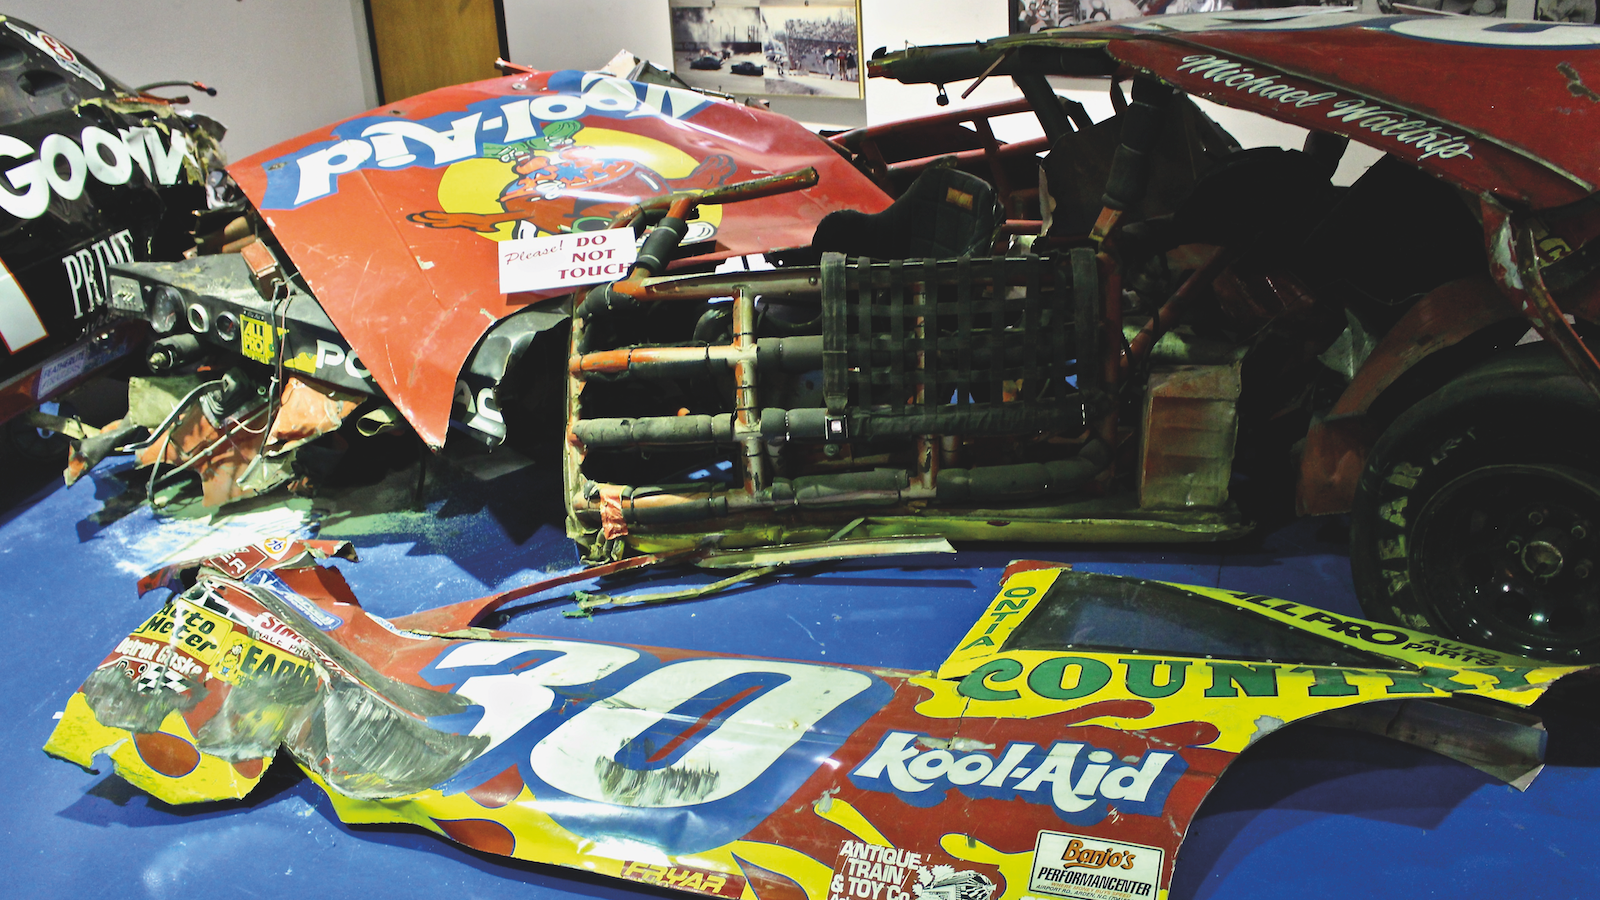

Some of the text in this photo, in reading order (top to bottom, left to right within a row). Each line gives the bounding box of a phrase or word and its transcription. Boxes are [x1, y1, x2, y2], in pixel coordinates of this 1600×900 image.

[1176, 54, 1474, 161] Michael Waltrip
[295, 71, 706, 205] Kool-Aid
[504, 235, 607, 265] Please! DO
[572, 248, 616, 264] NOT
[558, 262, 632, 280] TOUCH
[244, 322, 263, 338] ALL
[244, 336, 263, 354] PRO
[267, 540, 285, 551] 76
[158, 602, 215, 634] Auto
[960, 586, 1037, 652] ONTIA
[1300, 611, 1410, 646] PRO
[115, 637, 160, 660] Detroit
[134, 616, 217, 652] Meter
[1401, 642, 1499, 666] PARTS
[1420, 639, 1502, 660] AUTO
[435, 640, 873, 807] 30
[853, 731, 1174, 813] Kool-Aid
[839, 840, 922, 870] ANTIQUE
[1061, 839, 1136, 870] Banjo's
[623, 861, 727, 894] FRYAR
[848, 857, 904, 886] TRAIN
[1037, 866, 1152, 896] PERFORMANCENTER
[831, 874, 845, 893] &
[848, 877, 885, 900] TOY
